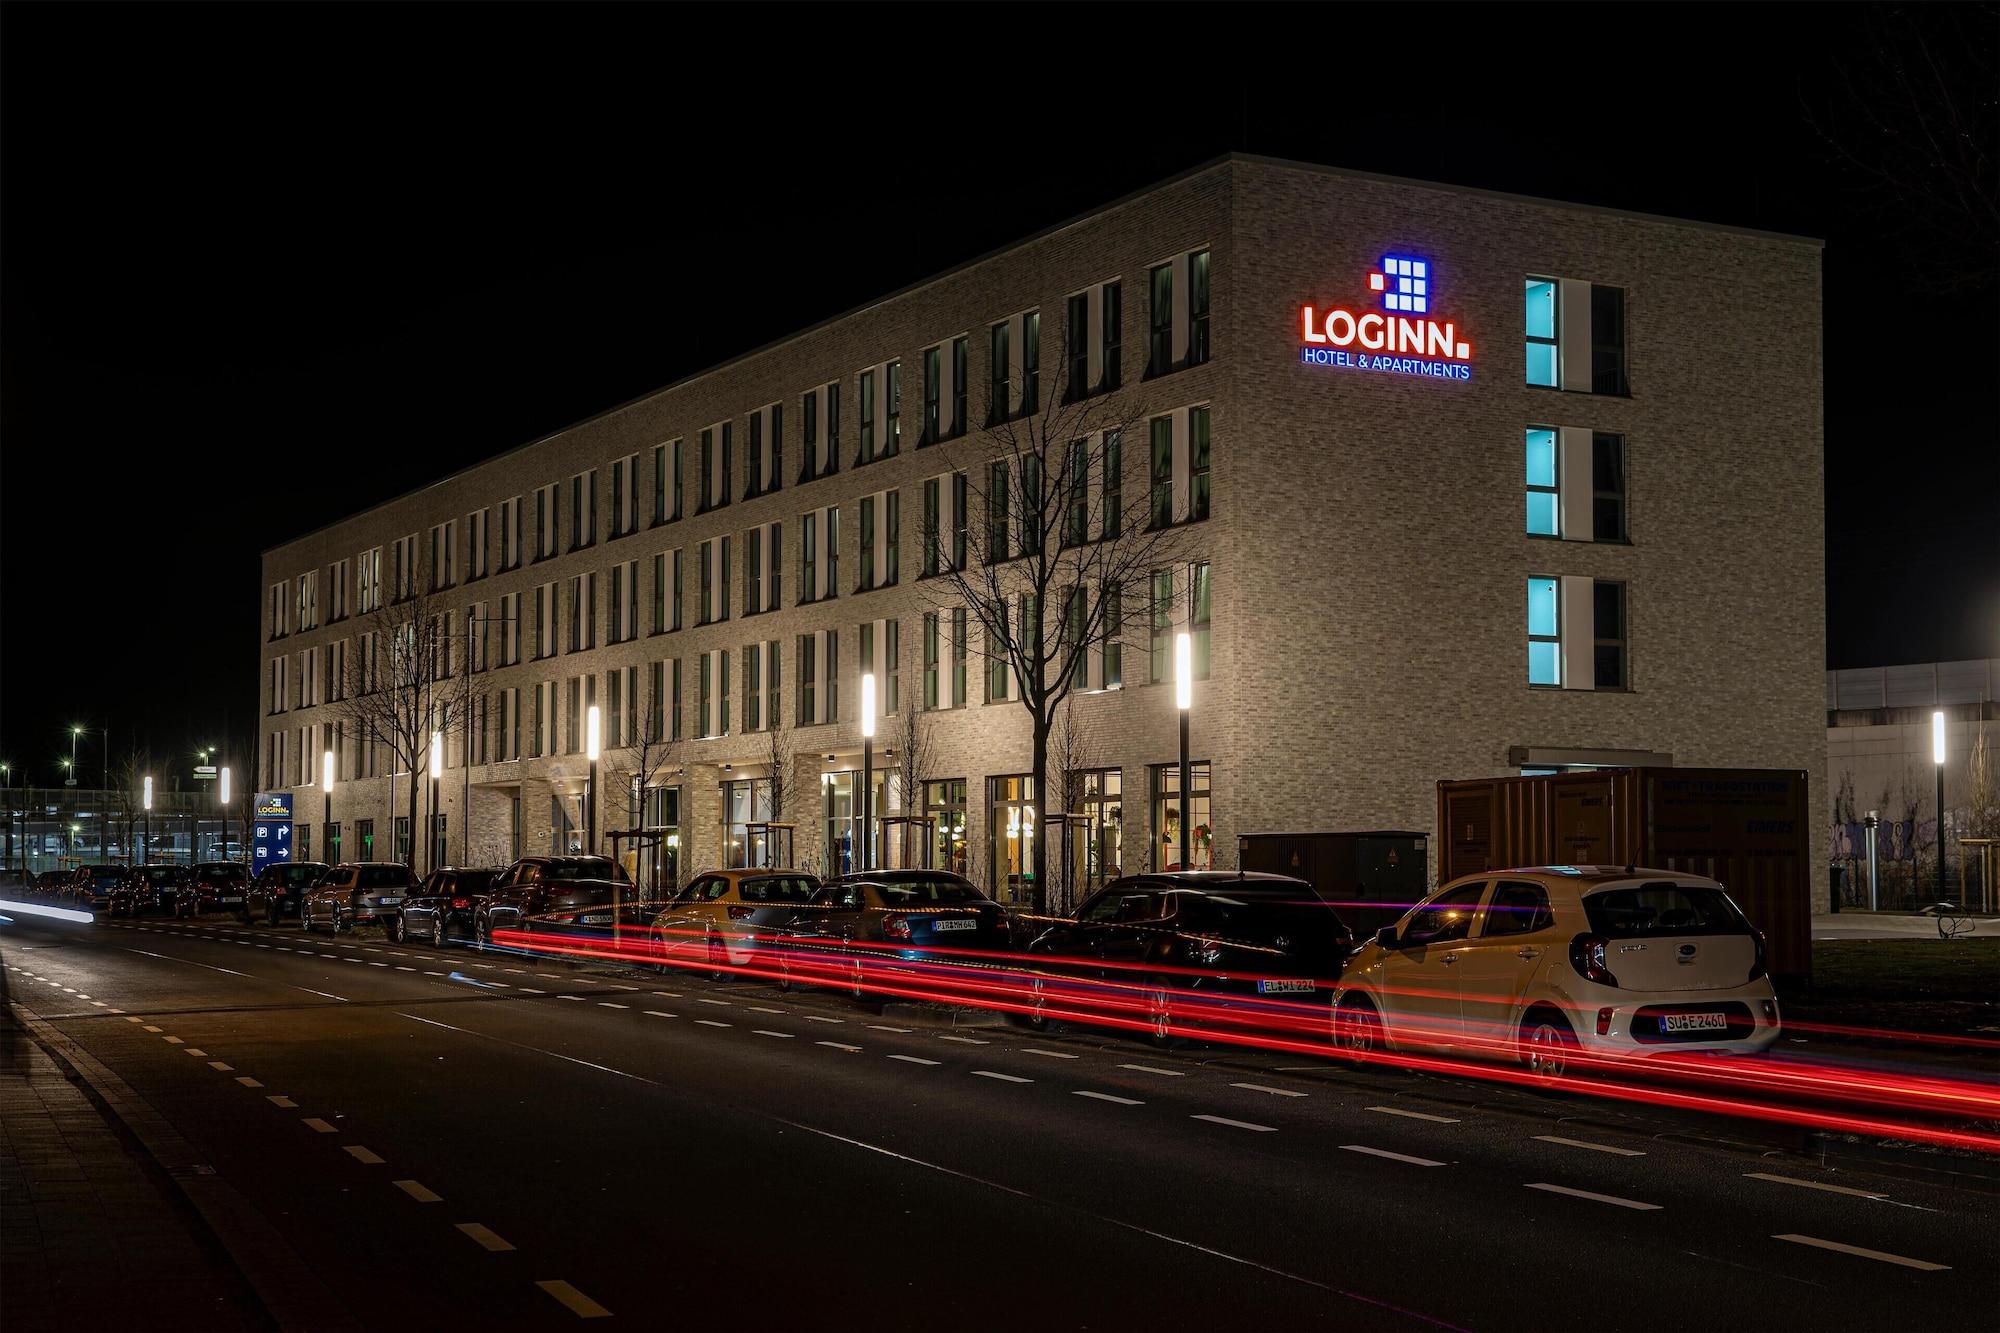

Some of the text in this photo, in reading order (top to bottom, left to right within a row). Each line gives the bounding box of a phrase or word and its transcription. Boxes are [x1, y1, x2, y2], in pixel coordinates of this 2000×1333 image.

[1304, 348, 1470, 379] HOTEL & APARTMENTS
[1697, 1014, 1725, 1028] 2460
